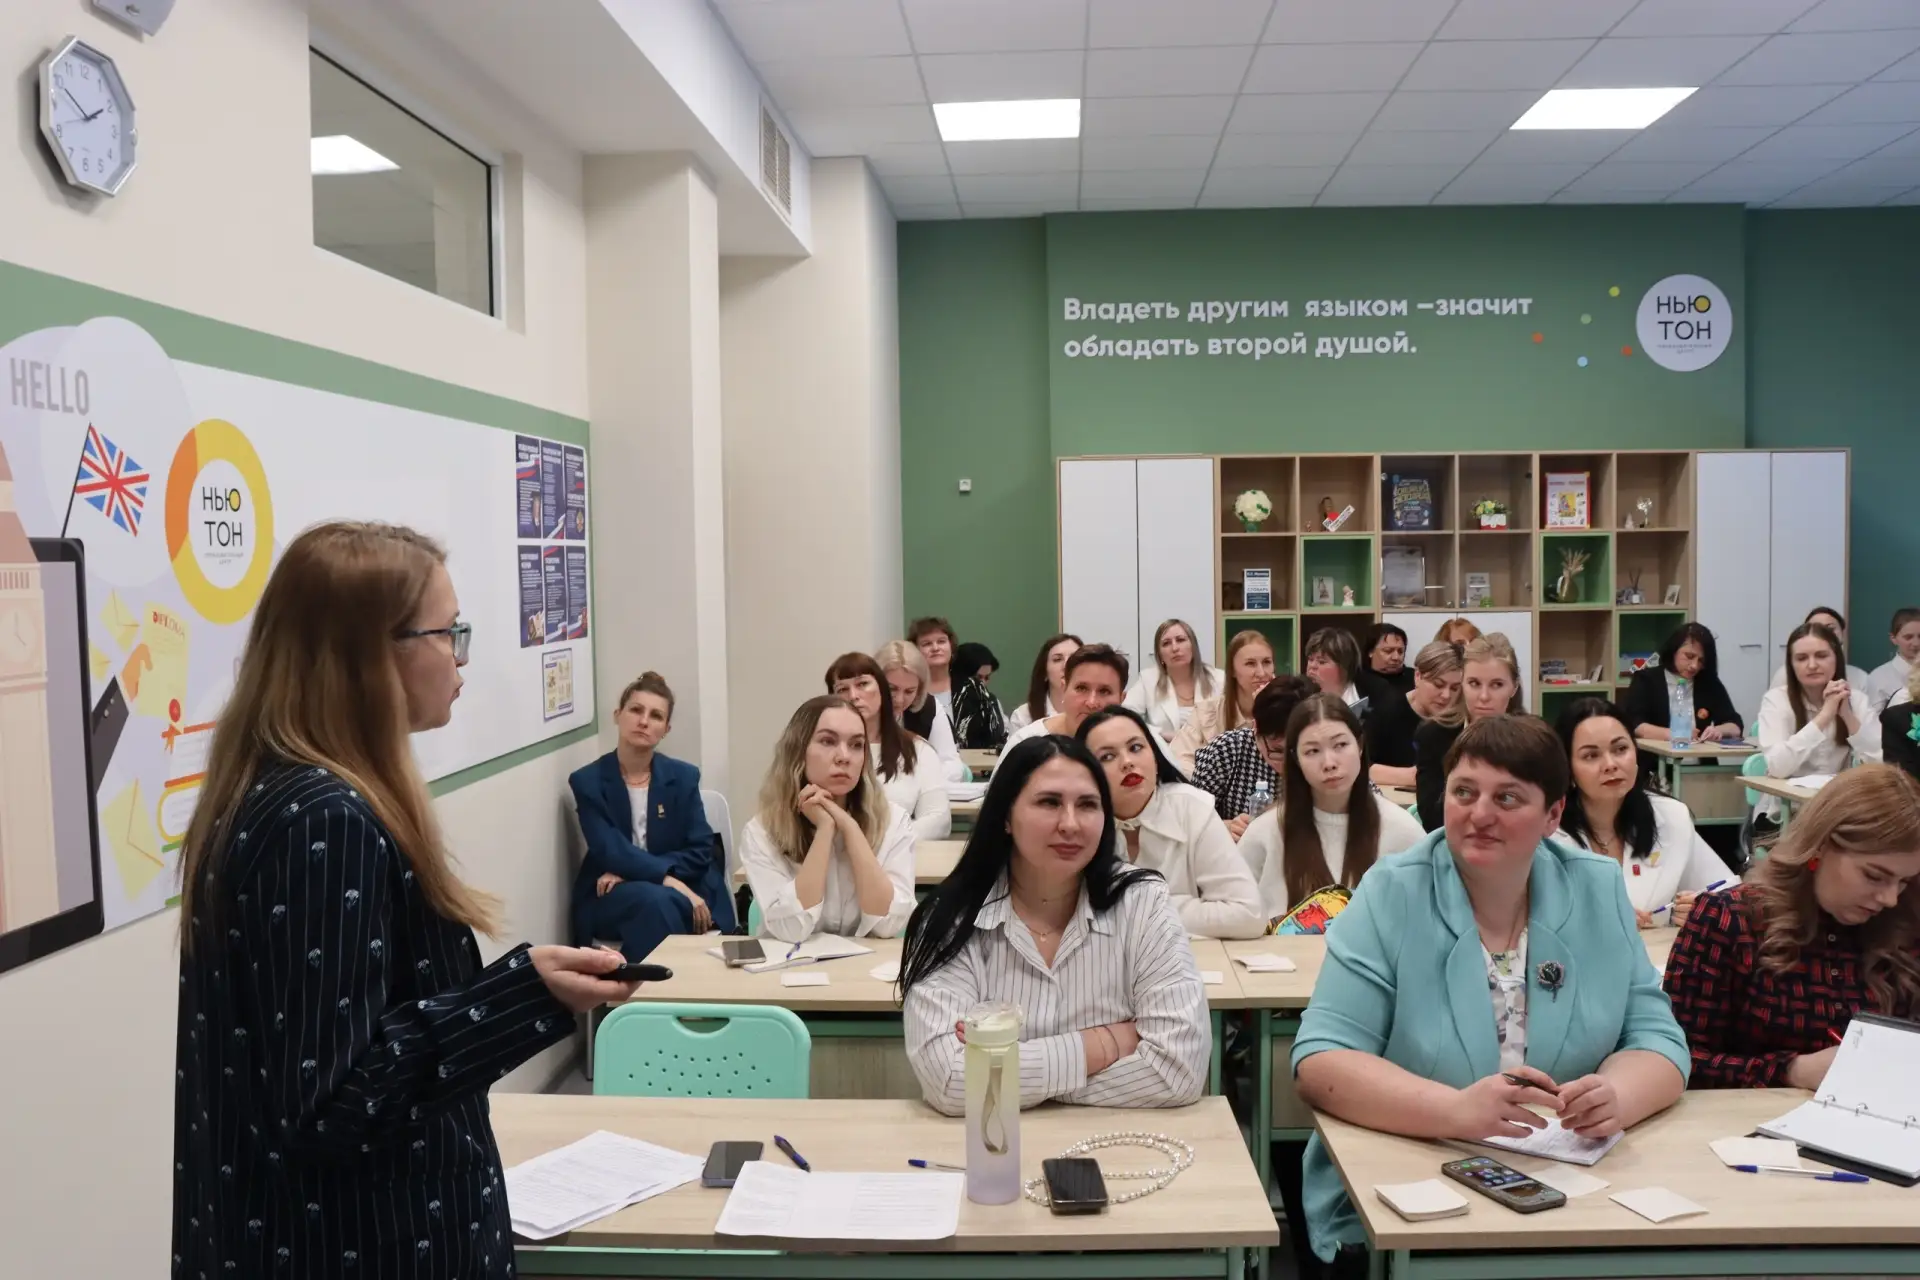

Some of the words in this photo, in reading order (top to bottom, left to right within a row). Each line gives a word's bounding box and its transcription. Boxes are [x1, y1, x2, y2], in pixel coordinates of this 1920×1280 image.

[1064, 298, 1180, 323] Владеть
[1187, 300, 1289, 324] другим
[1305, 299, 1408, 317] языком
[1657, 295, 1711, 314] НЬЮ
[1657, 320, 1711, 340] ТОН
[1064, 334, 1200, 360] обладать
[1207, 332, 1307, 360] второй
[1315, 331, 1417, 359] душой.
[10, 357, 90, 416] HELLO
[202, 486, 241, 512] НЬЮ
[204, 521, 242, 547] ТОН
